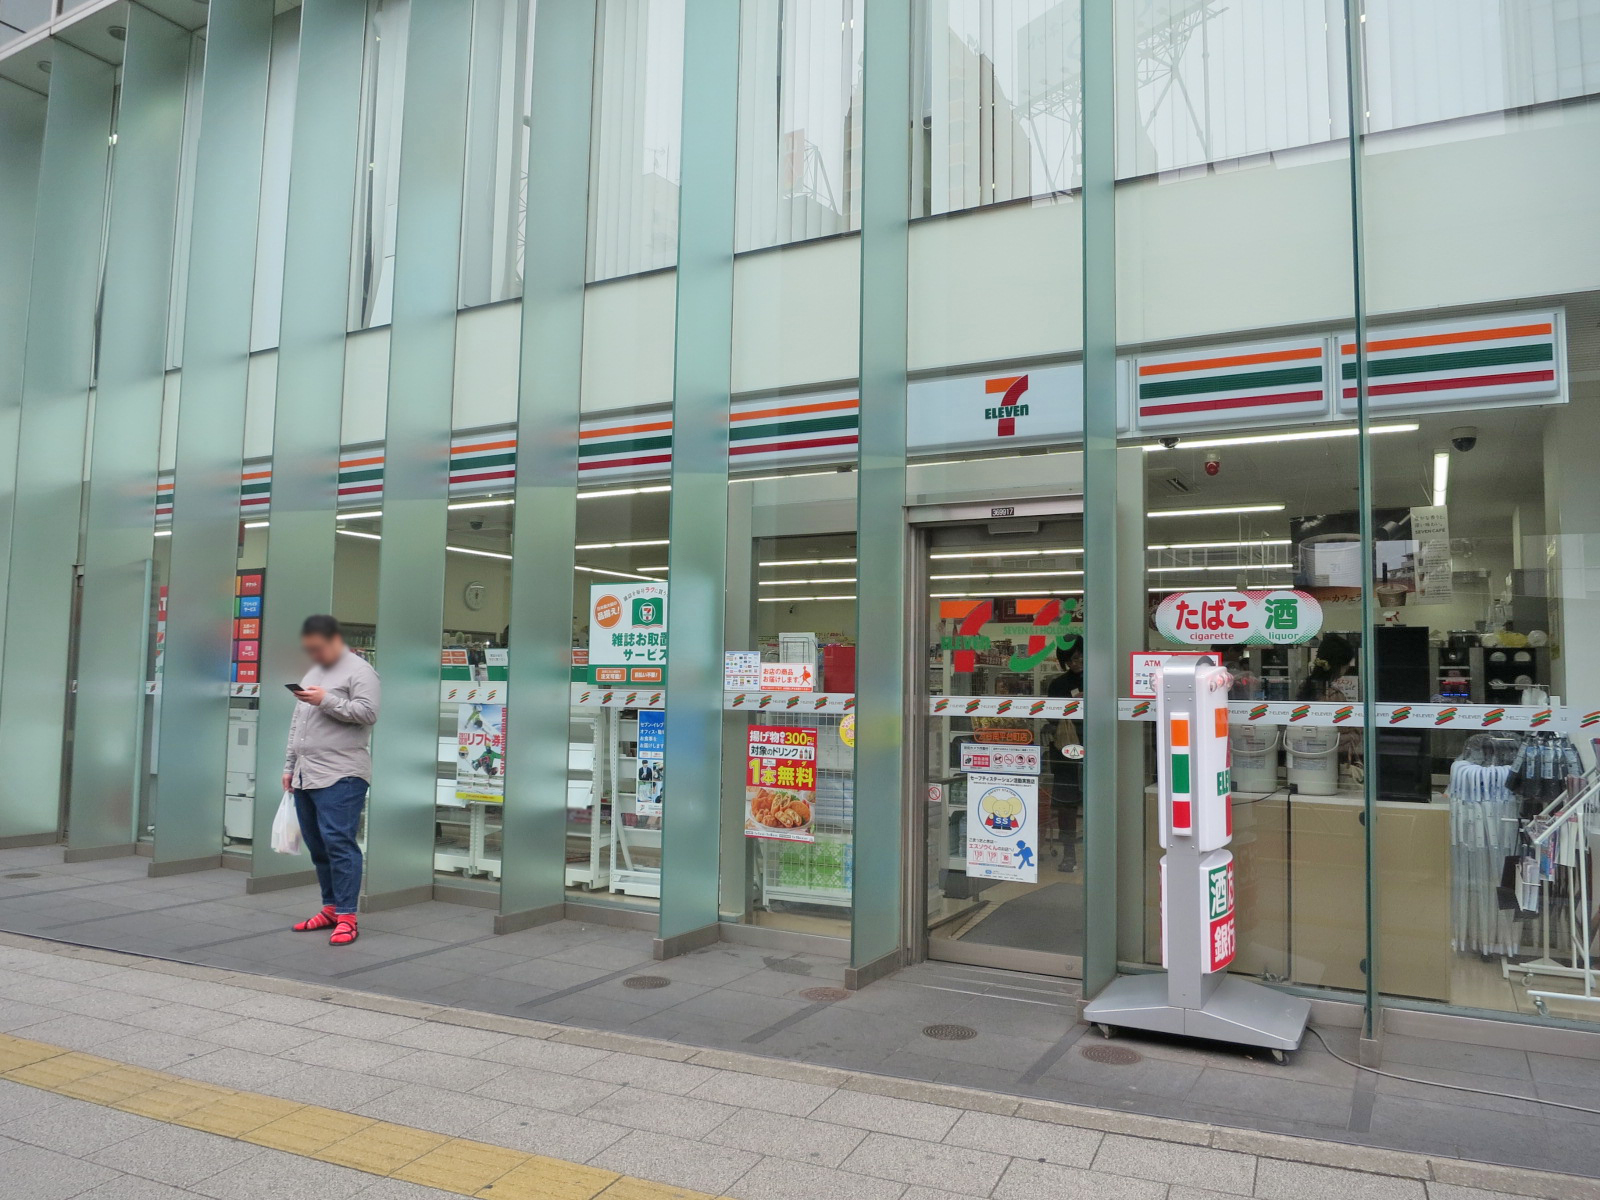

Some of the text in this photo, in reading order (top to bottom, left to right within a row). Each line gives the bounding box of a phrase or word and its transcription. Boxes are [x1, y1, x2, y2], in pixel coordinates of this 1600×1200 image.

[1176, 598, 1298, 630] たばこ 酒
[1190, 632, 1299, 641] cigarette liquor
[750, 745, 799, 757] 対象のドリンク
[748, 757, 814, 788] 1本無料
[1211, 869, 1227, 917] 酒
